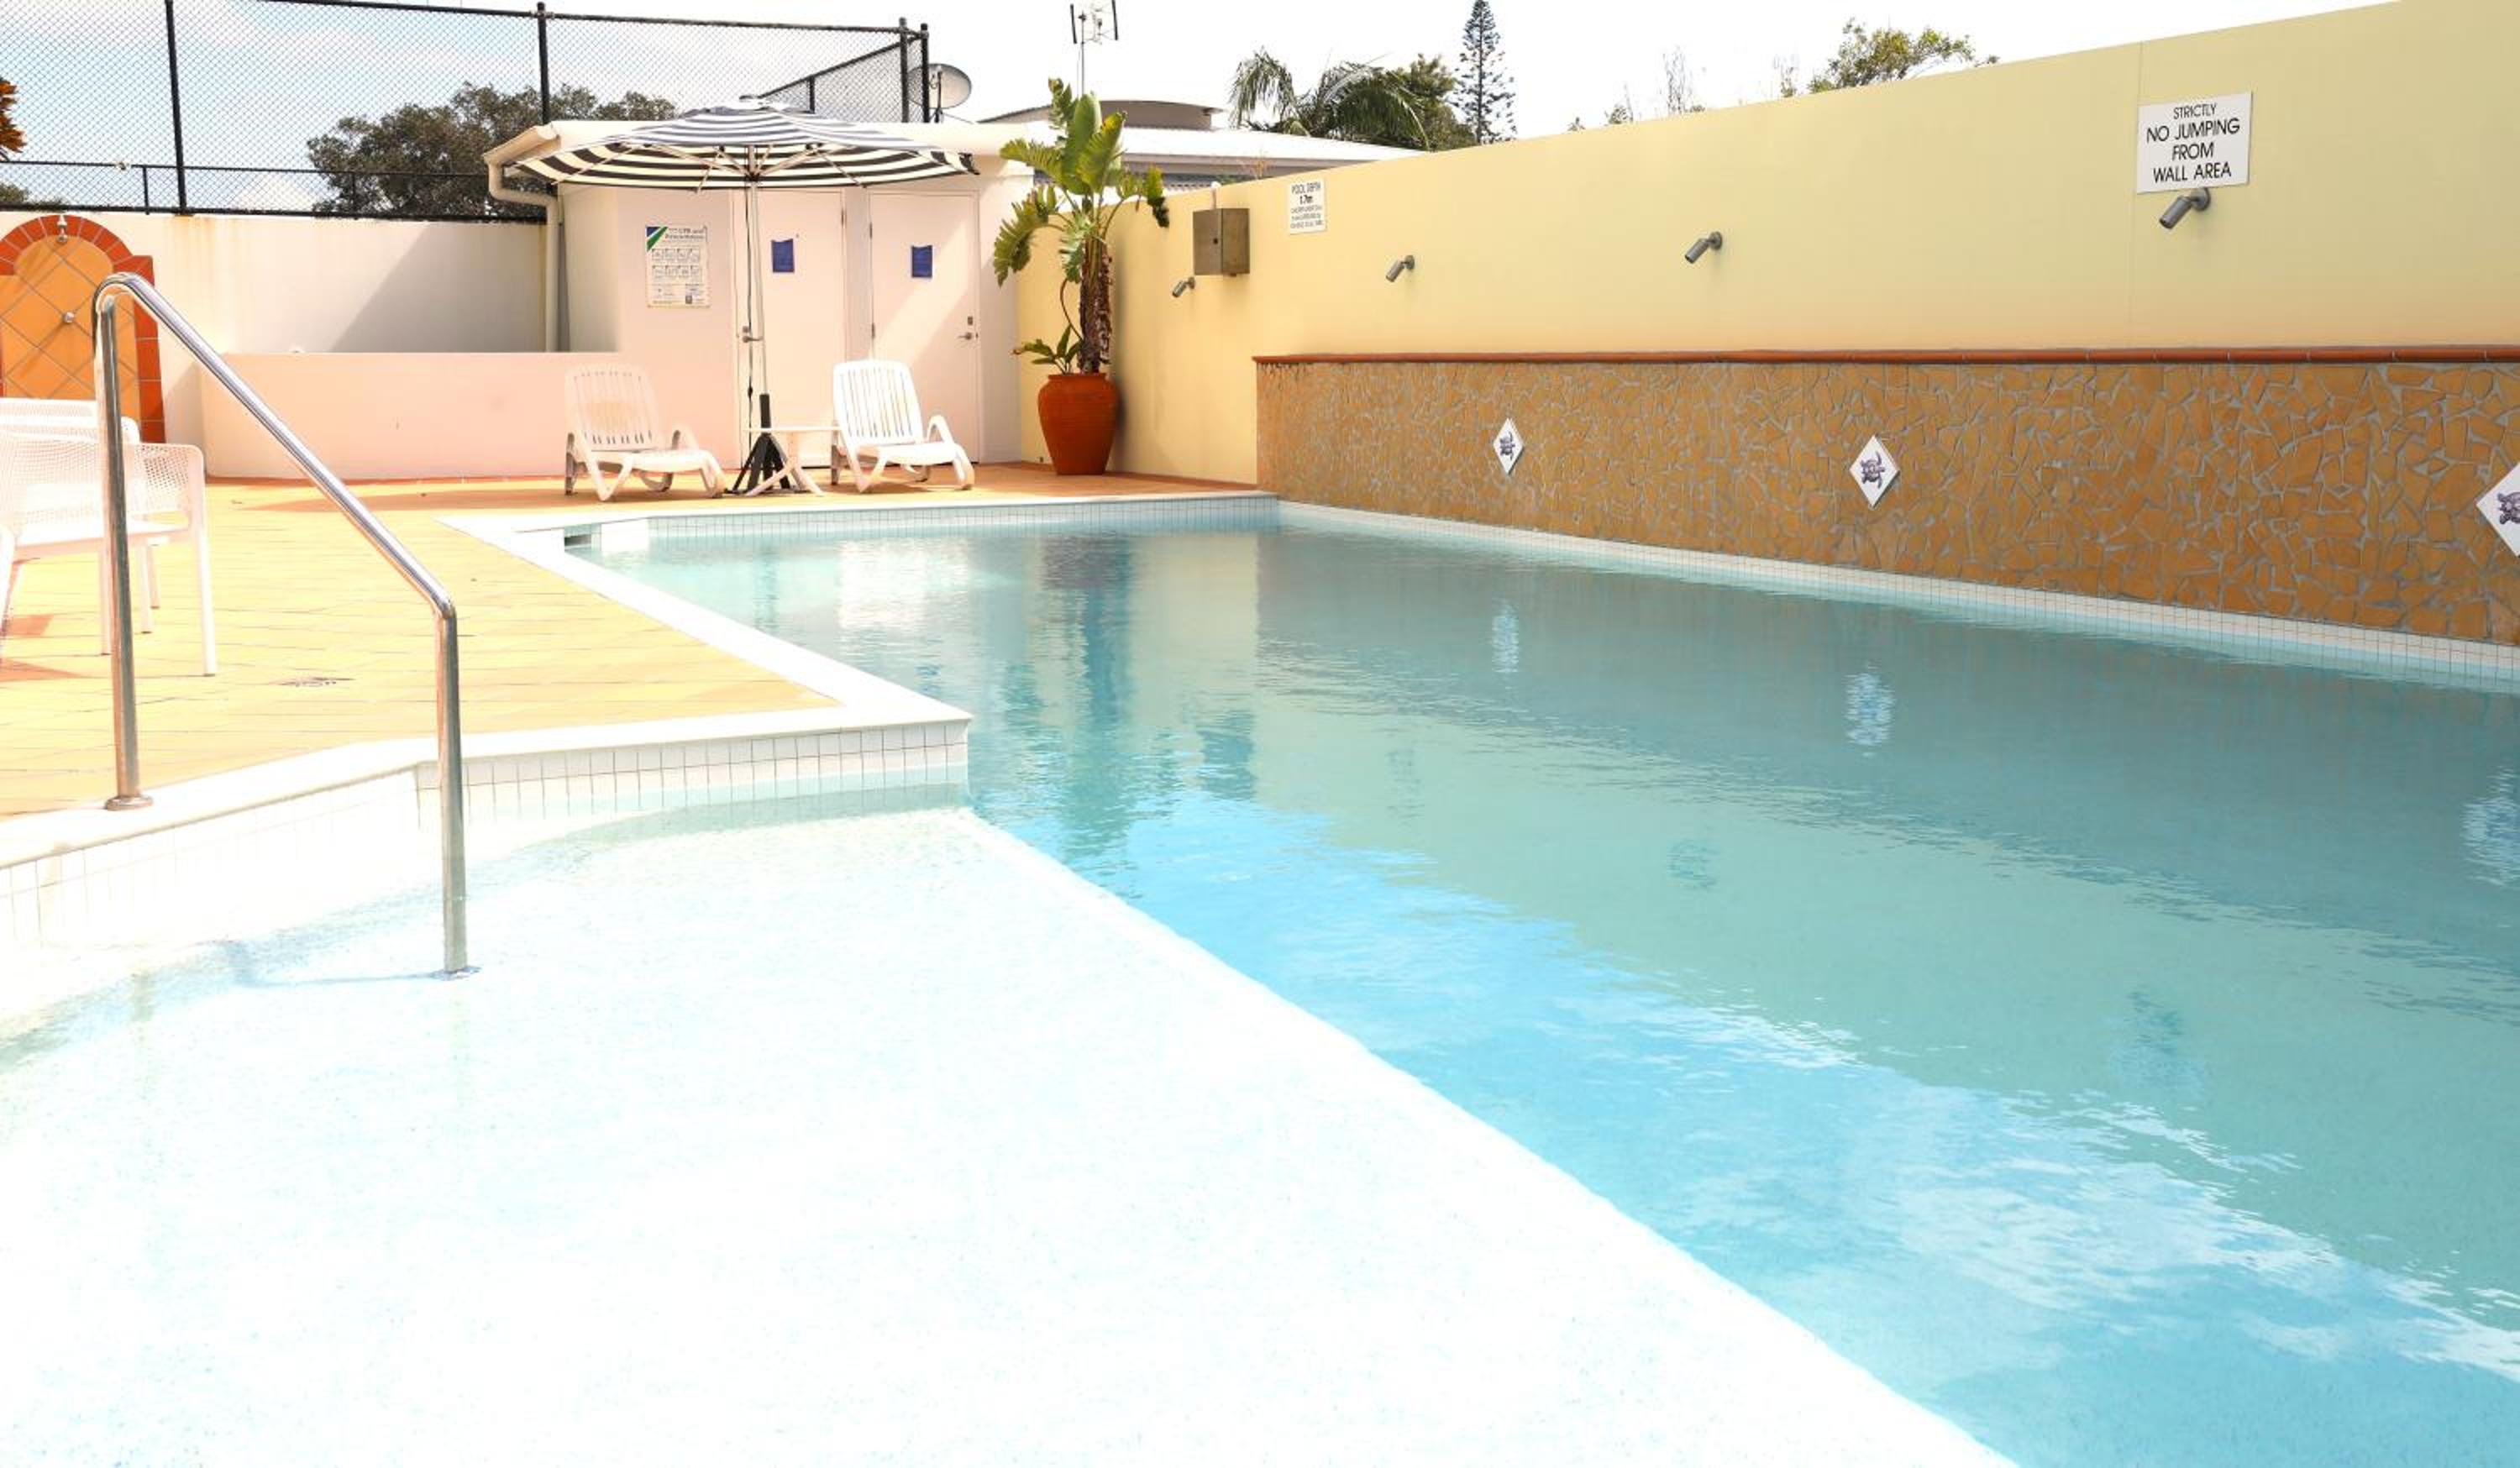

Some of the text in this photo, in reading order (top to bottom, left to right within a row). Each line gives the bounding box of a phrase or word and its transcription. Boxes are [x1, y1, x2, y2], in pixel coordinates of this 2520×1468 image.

[2173, 102, 2218, 120] STRICTLY
[2146, 118, 2240, 144] NO JUMPING
[2171, 141, 2215, 161] FROM
[2153, 161, 2232, 183] WALL AREA
[1291, 183, 1306, 195] POOL
